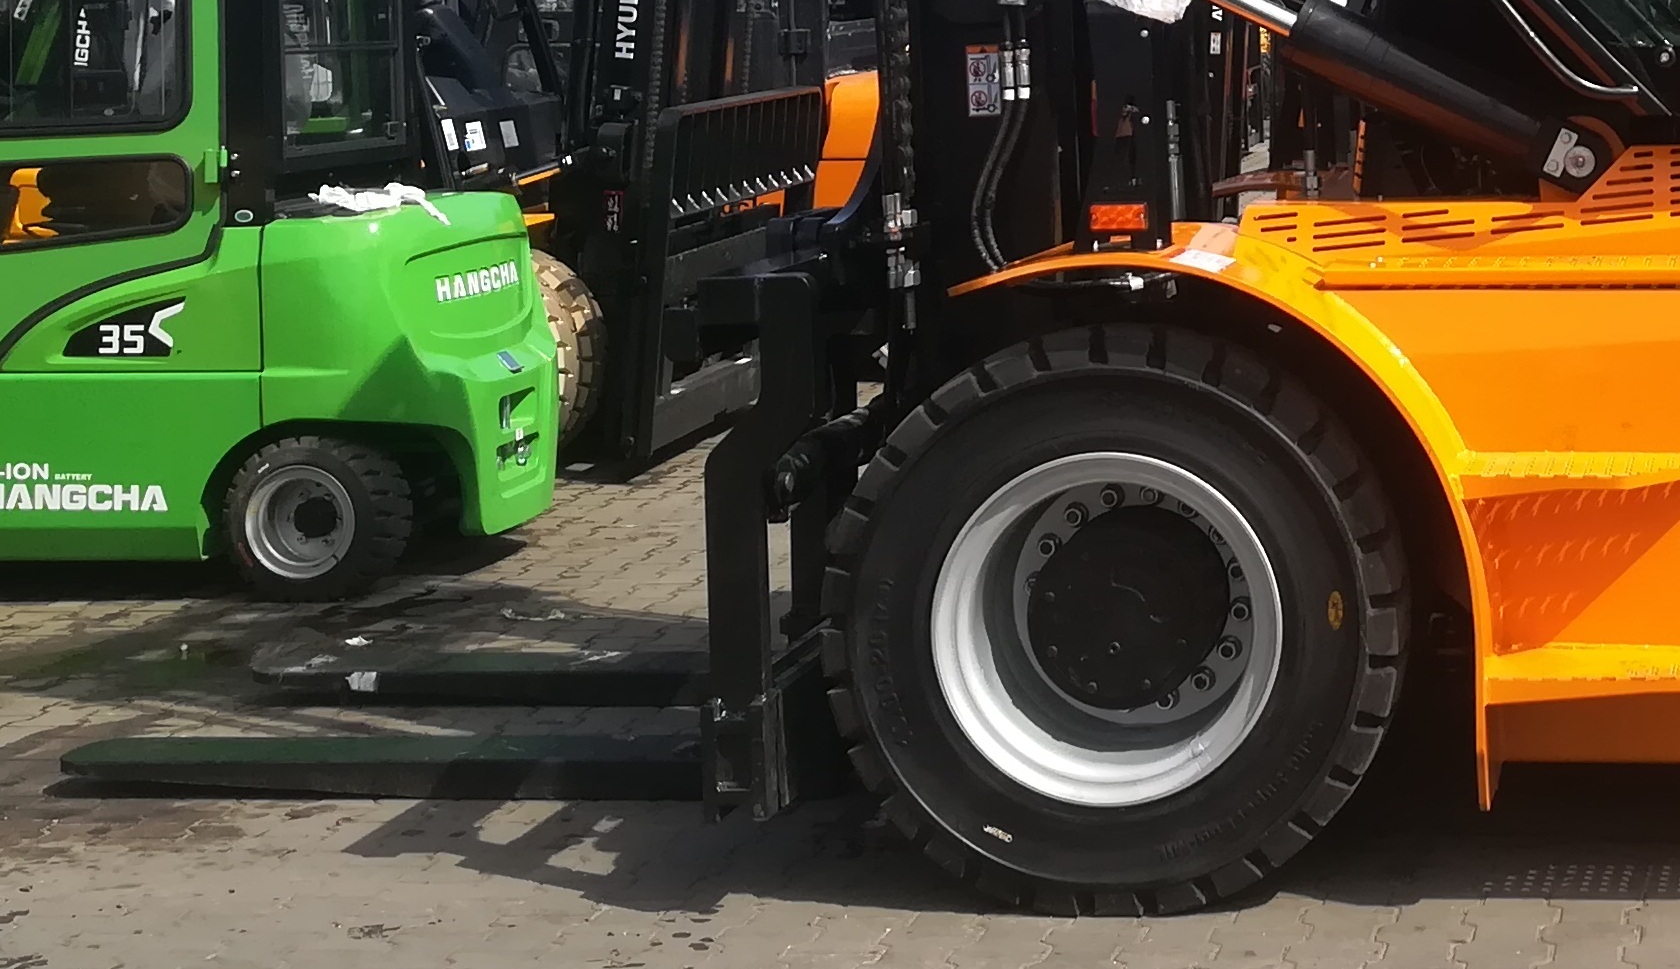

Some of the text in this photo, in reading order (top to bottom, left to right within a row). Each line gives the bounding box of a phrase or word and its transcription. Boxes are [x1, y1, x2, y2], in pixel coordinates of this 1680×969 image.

[74, 7, 90, 66] GCH
[435, 260, 519, 302] HANGCHA
[99, 324, 144, 354] 35
[54, 473, 92, 481] BATTERY
